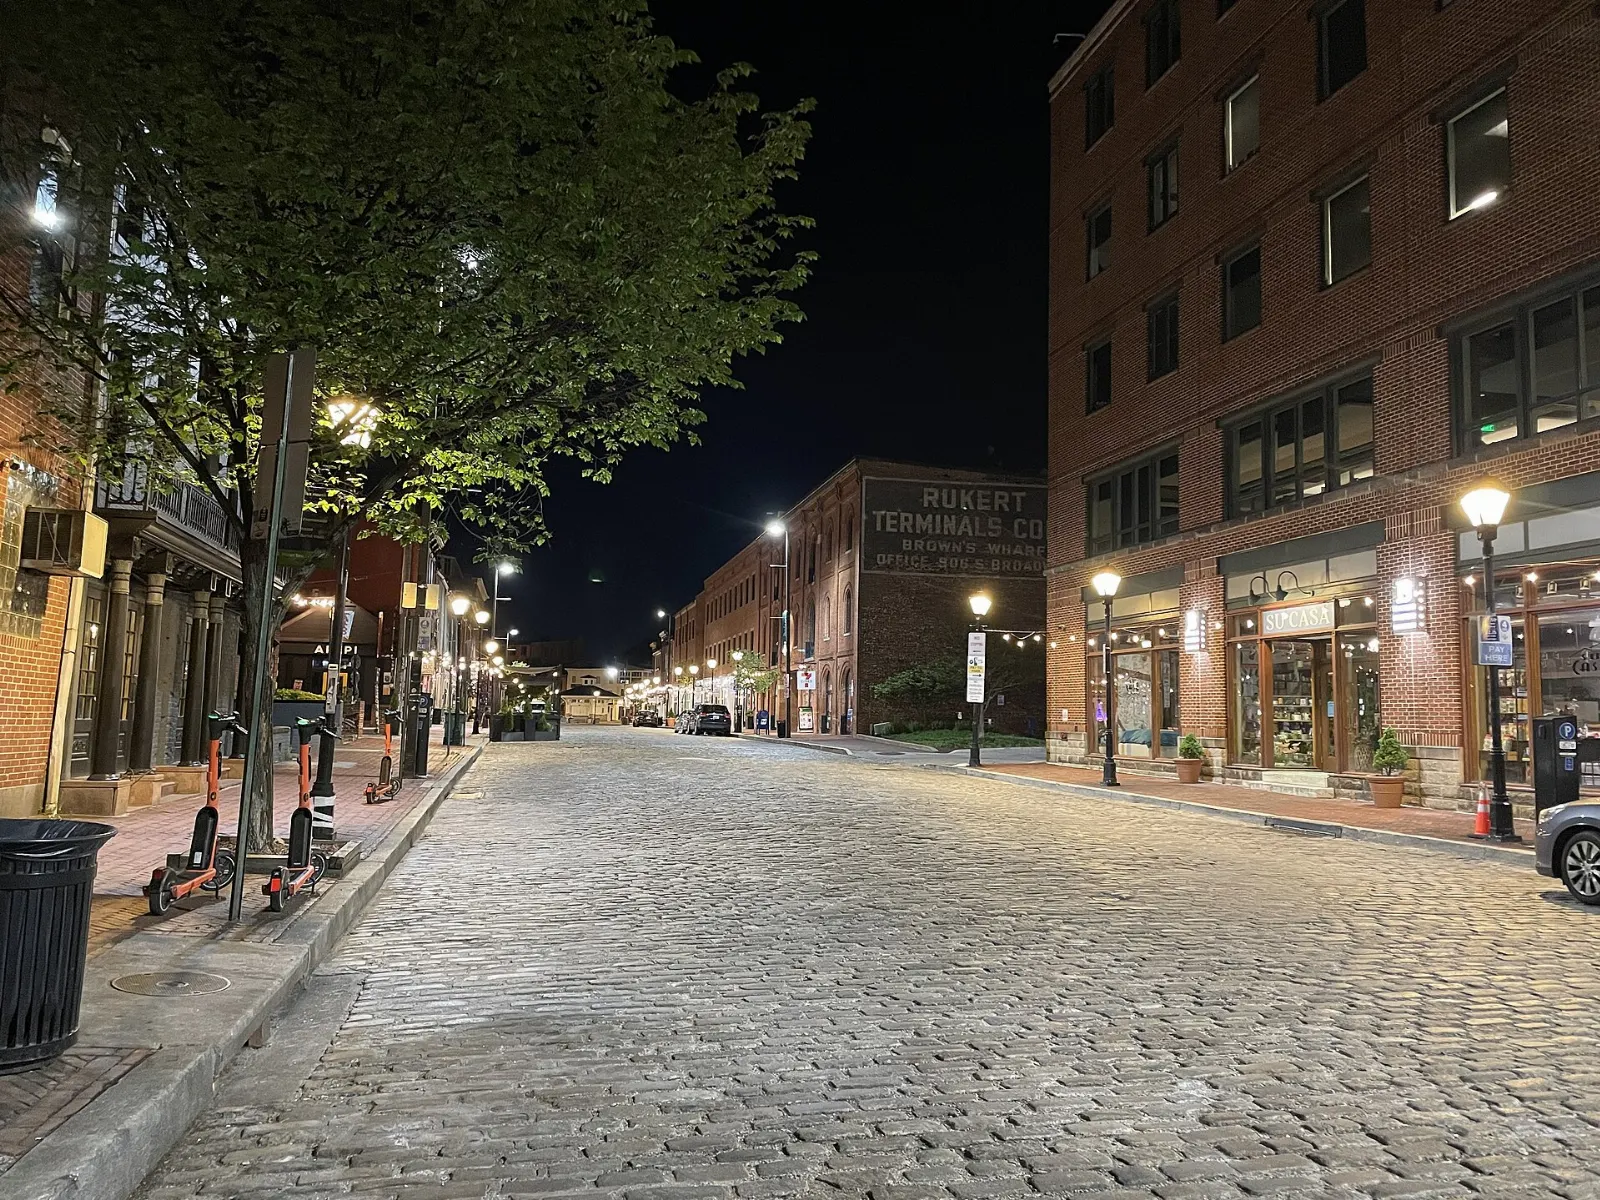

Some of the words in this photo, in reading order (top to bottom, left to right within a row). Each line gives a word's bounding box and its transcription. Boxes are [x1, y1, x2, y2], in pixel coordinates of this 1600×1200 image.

[923, 487, 1026, 512] RUKERT
[872, 510, 1002, 537] TERMINALS
[902, 539, 976, 554] BROWN'S
[988, 543, 1046, 557] WHARF
[876, 553, 928, 567] OFFICE
[1266, 613, 1284, 631] SU
[1289, 606, 1331, 628] CASA
[1488, 645, 1506, 654] PAY
[1484, 654, 1509, 662] HERE
[1564, 726, 1572, 737] P
